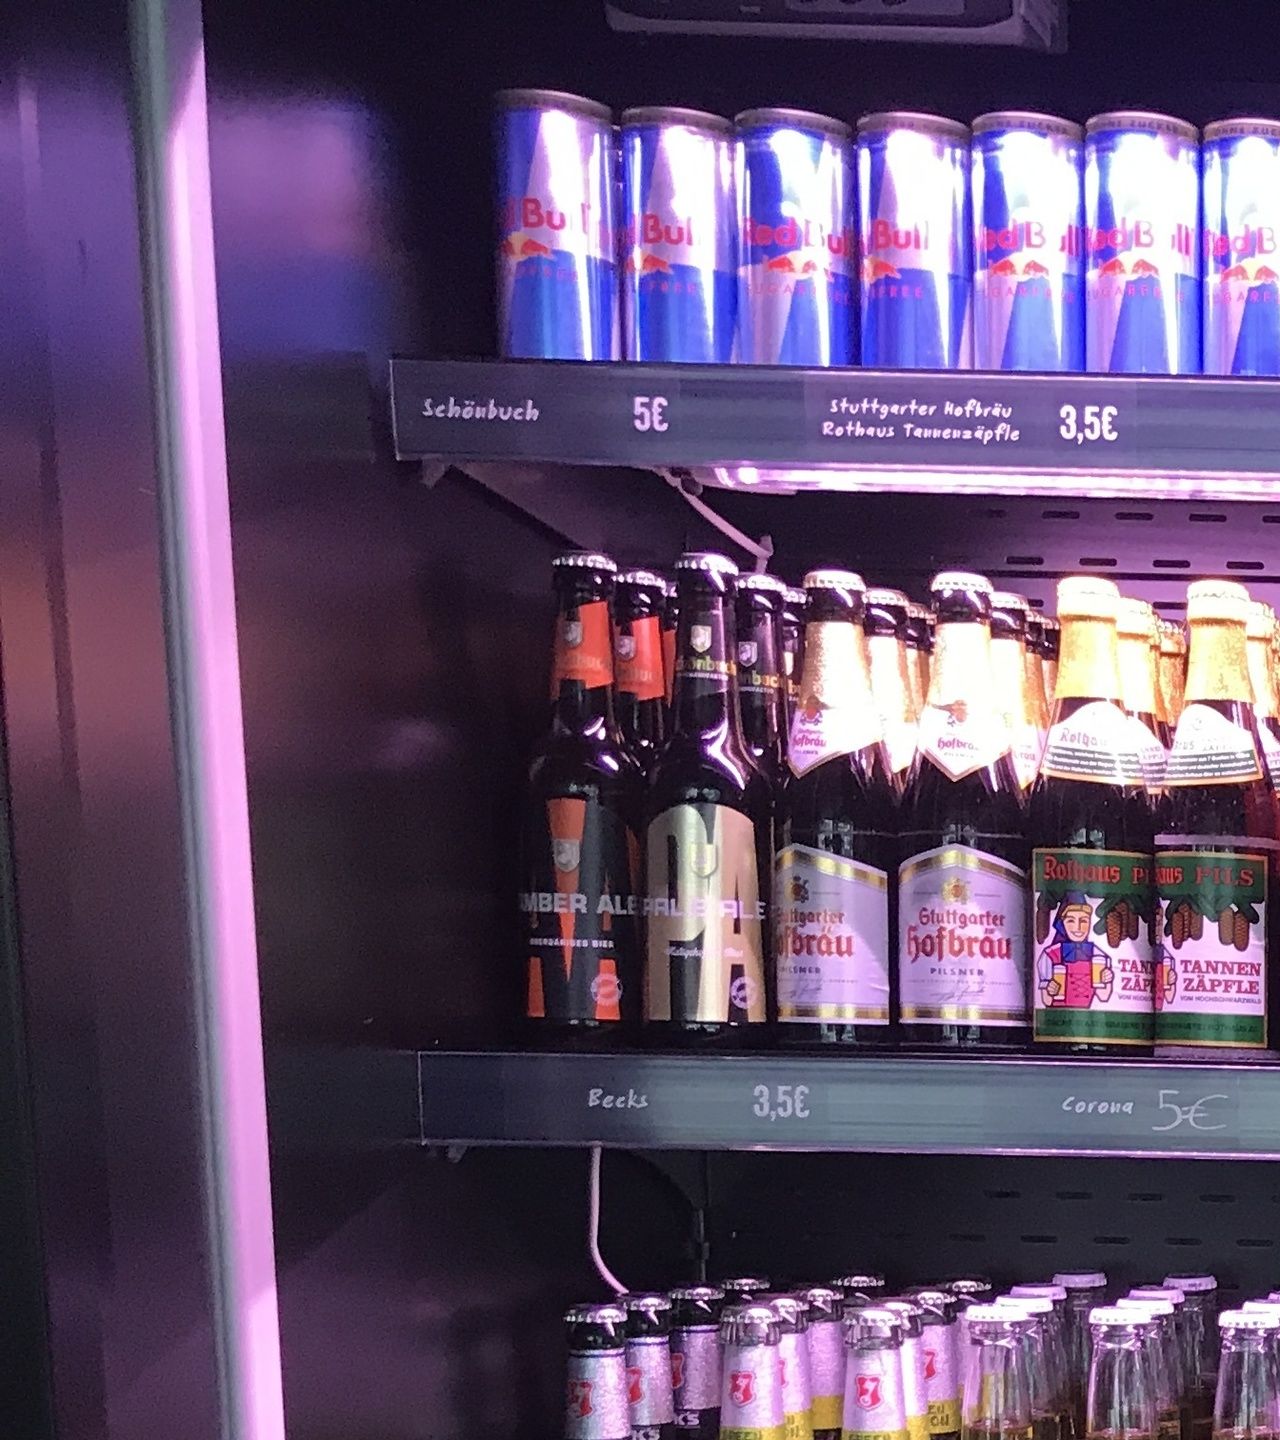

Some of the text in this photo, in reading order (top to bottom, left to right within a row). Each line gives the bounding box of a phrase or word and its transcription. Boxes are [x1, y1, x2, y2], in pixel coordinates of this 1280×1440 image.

[422, 397, 541, 424] Schönbuch
[632, 397, 669, 432] 5€
[829, 398, 1014, 420] Stuttgarter Hofbräu
[822, 420, 1021, 445] Rothaus Tannenzäpfle
[1059, 405, 1119, 443] 3,5€
[1196, 866, 1254, 887] PILS
[918, 907, 1005, 928] Stuttgarter
[930, 967, 984, 976] PILSNER
[1180, 959, 1261, 977] TANNEN
[1182, 977, 1260, 995] ZÄPFLE
[588, 1088, 649, 1110] Becks
[753, 1086, 810, 1121] 3,5€
[1061, 1096, 1134, 1116] Corona
